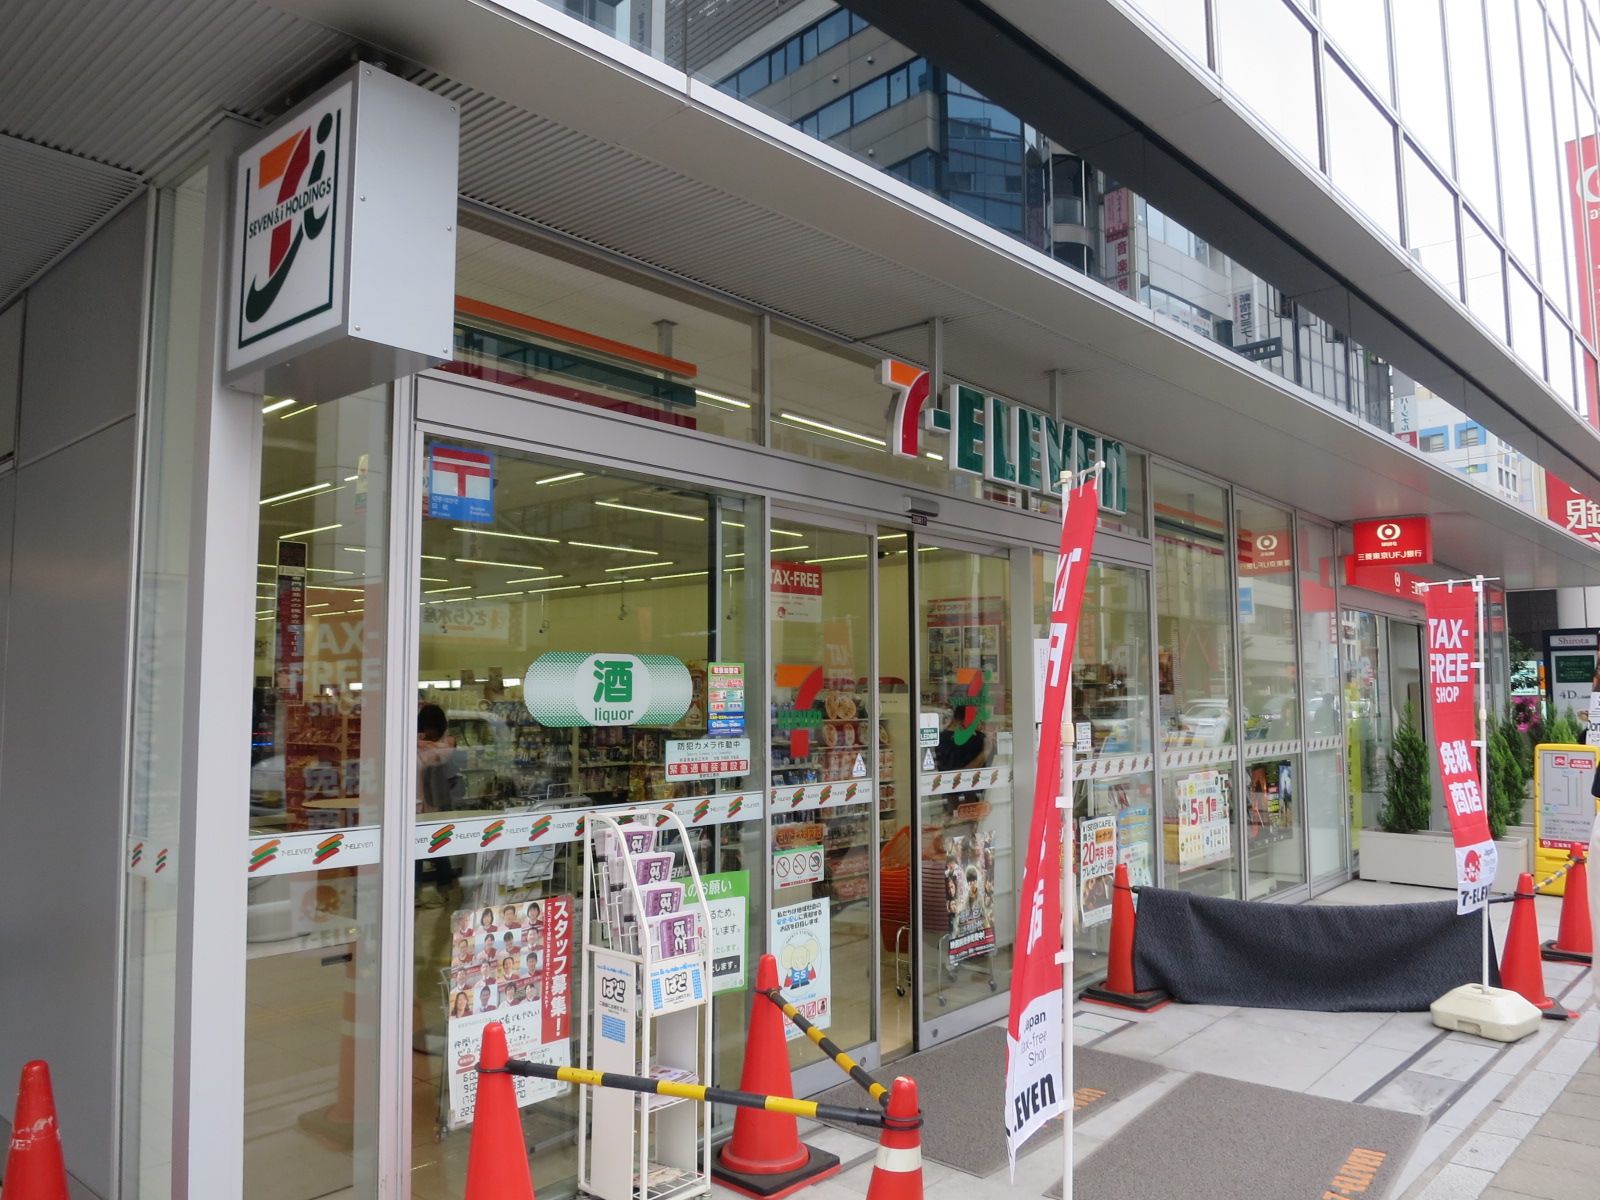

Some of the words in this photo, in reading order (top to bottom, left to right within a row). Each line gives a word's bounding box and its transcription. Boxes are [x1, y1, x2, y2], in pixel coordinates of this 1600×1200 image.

[285, 177, 332, 216] HOLDINGS
[1428, 618, 1469, 649] TAX-
[1429, 653, 1469, 683] FREE
[593, 659, 634, 703] 酒
[1435, 686, 1459, 703] SHOP
[594, 707, 634, 723] liquor
[677, 740, 740, 751] 防犯カメラ作動中
[1440, 739, 1473, 775] 免税
[1449, 779, 1483, 816] 商店
[665, 971, 687, 996] ぱど
[794, 969, 807, 981] SS
[602, 977, 626, 1003] ぱど
[1024, 1011, 1046, 1031] apan
[1021, 1031, 1047, 1053] ax-free
